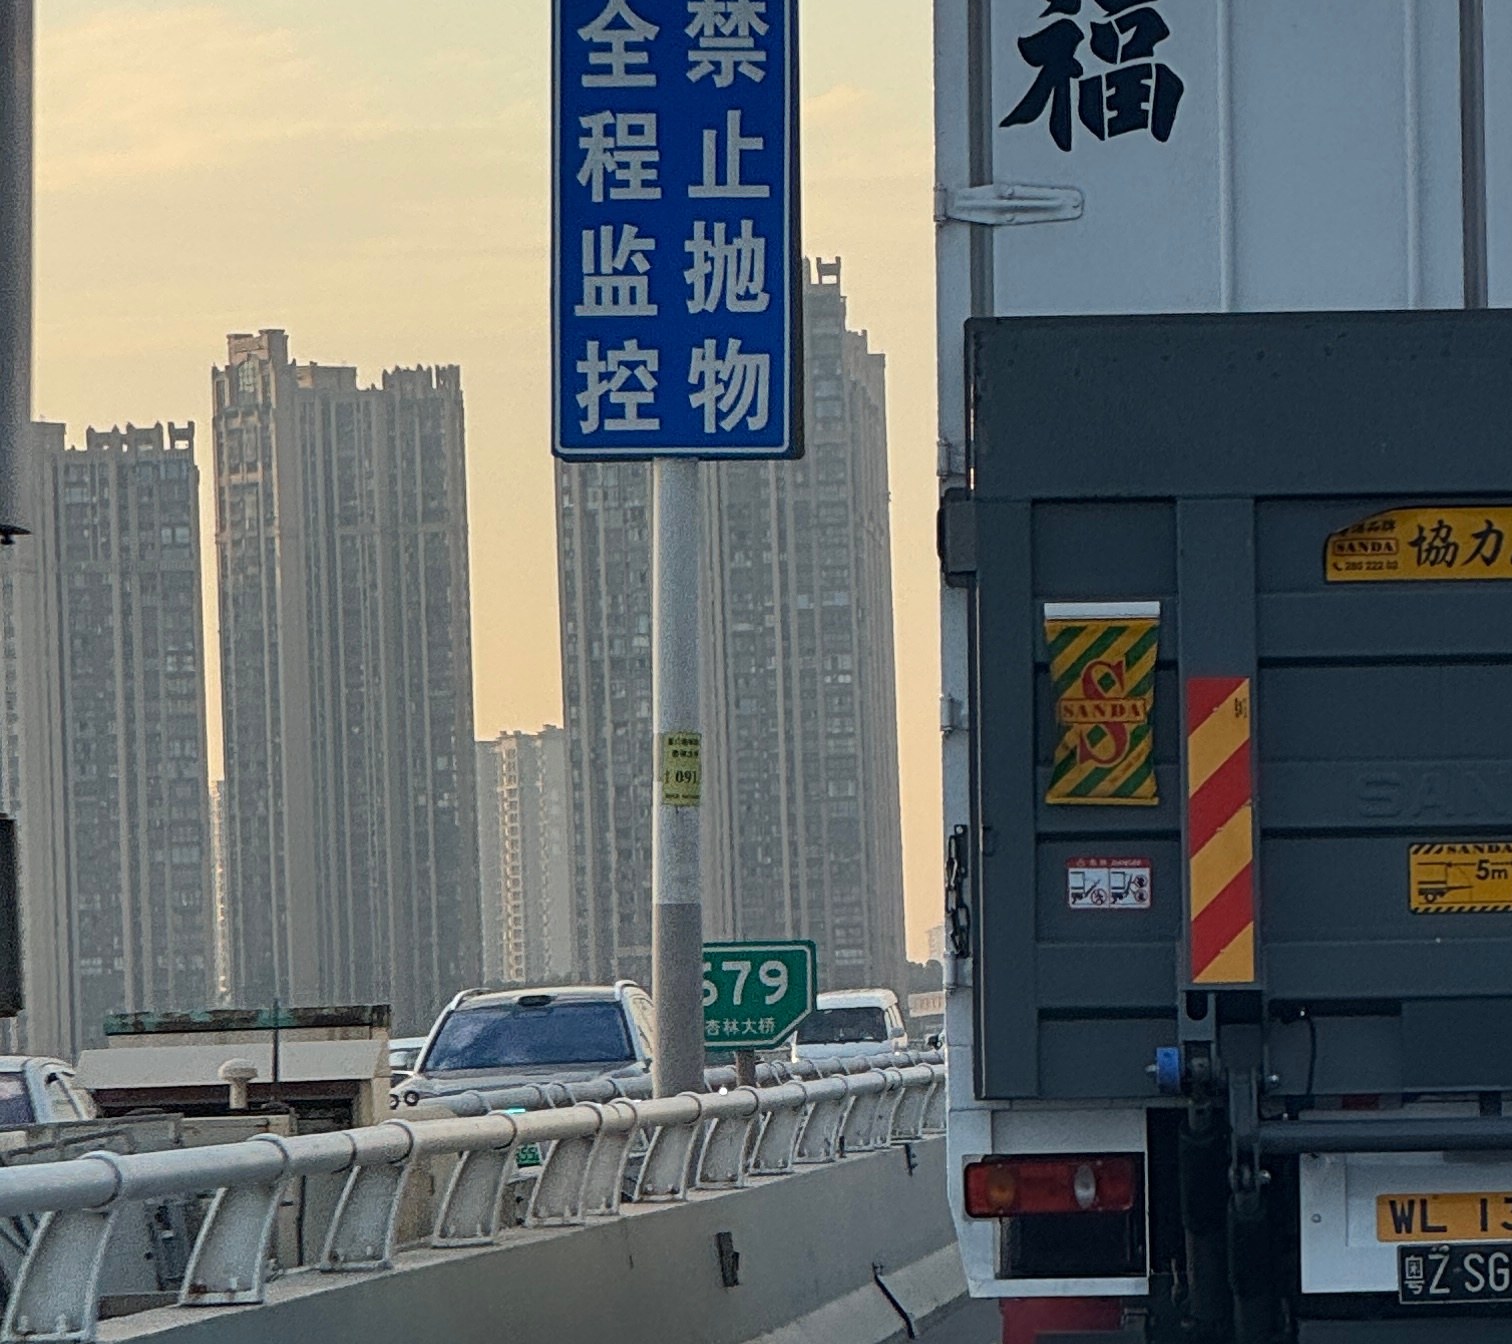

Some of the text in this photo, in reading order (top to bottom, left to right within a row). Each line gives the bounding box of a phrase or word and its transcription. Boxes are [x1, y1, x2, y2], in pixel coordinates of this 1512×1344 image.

[1062, 702, 1142, 719] SANDA
[1446, 842, 1512, 854] SANDA
[1476, 859, 1508, 880] 5m
[705, 1017, 776, 1036] 杏林大桥
[1389, 1198, 1447, 1234] WL
